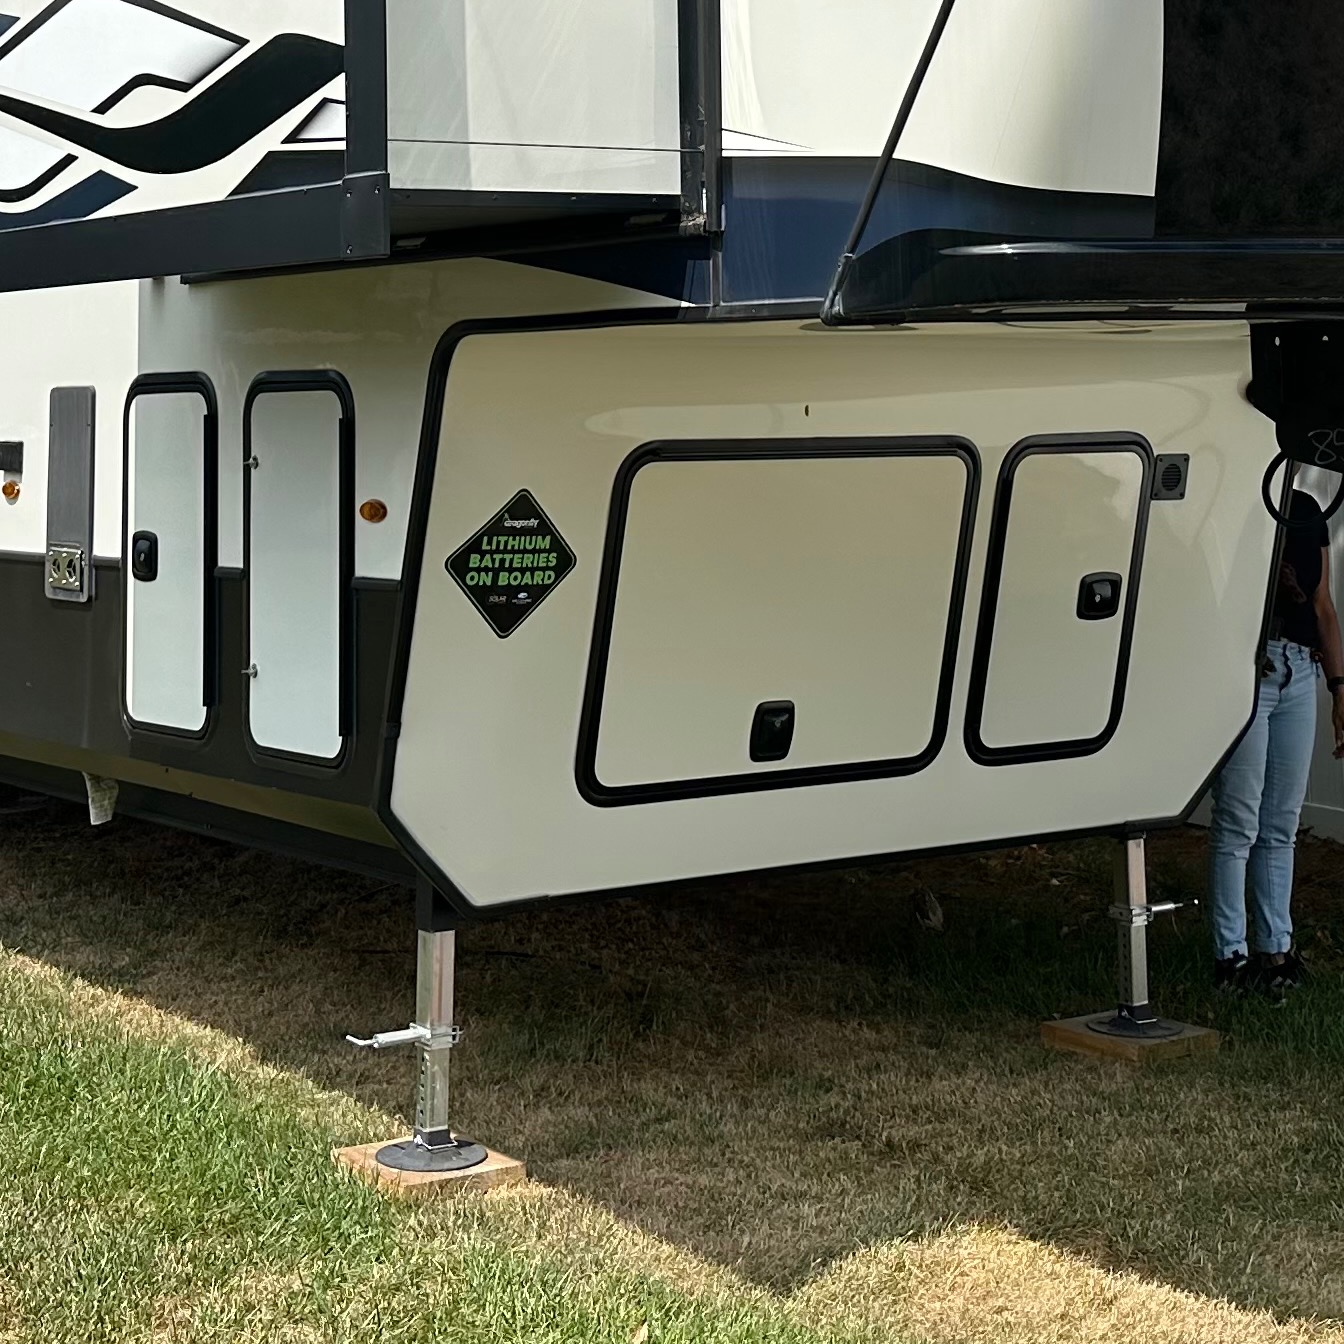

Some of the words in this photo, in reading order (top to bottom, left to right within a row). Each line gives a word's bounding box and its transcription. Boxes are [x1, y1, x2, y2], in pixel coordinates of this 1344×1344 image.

[481, 535, 552, 550] LITHIUM
[468, 552, 558, 568] BATTERIES
[465, 571, 493, 586] ON
[497, 570, 556, 586] BOARD
